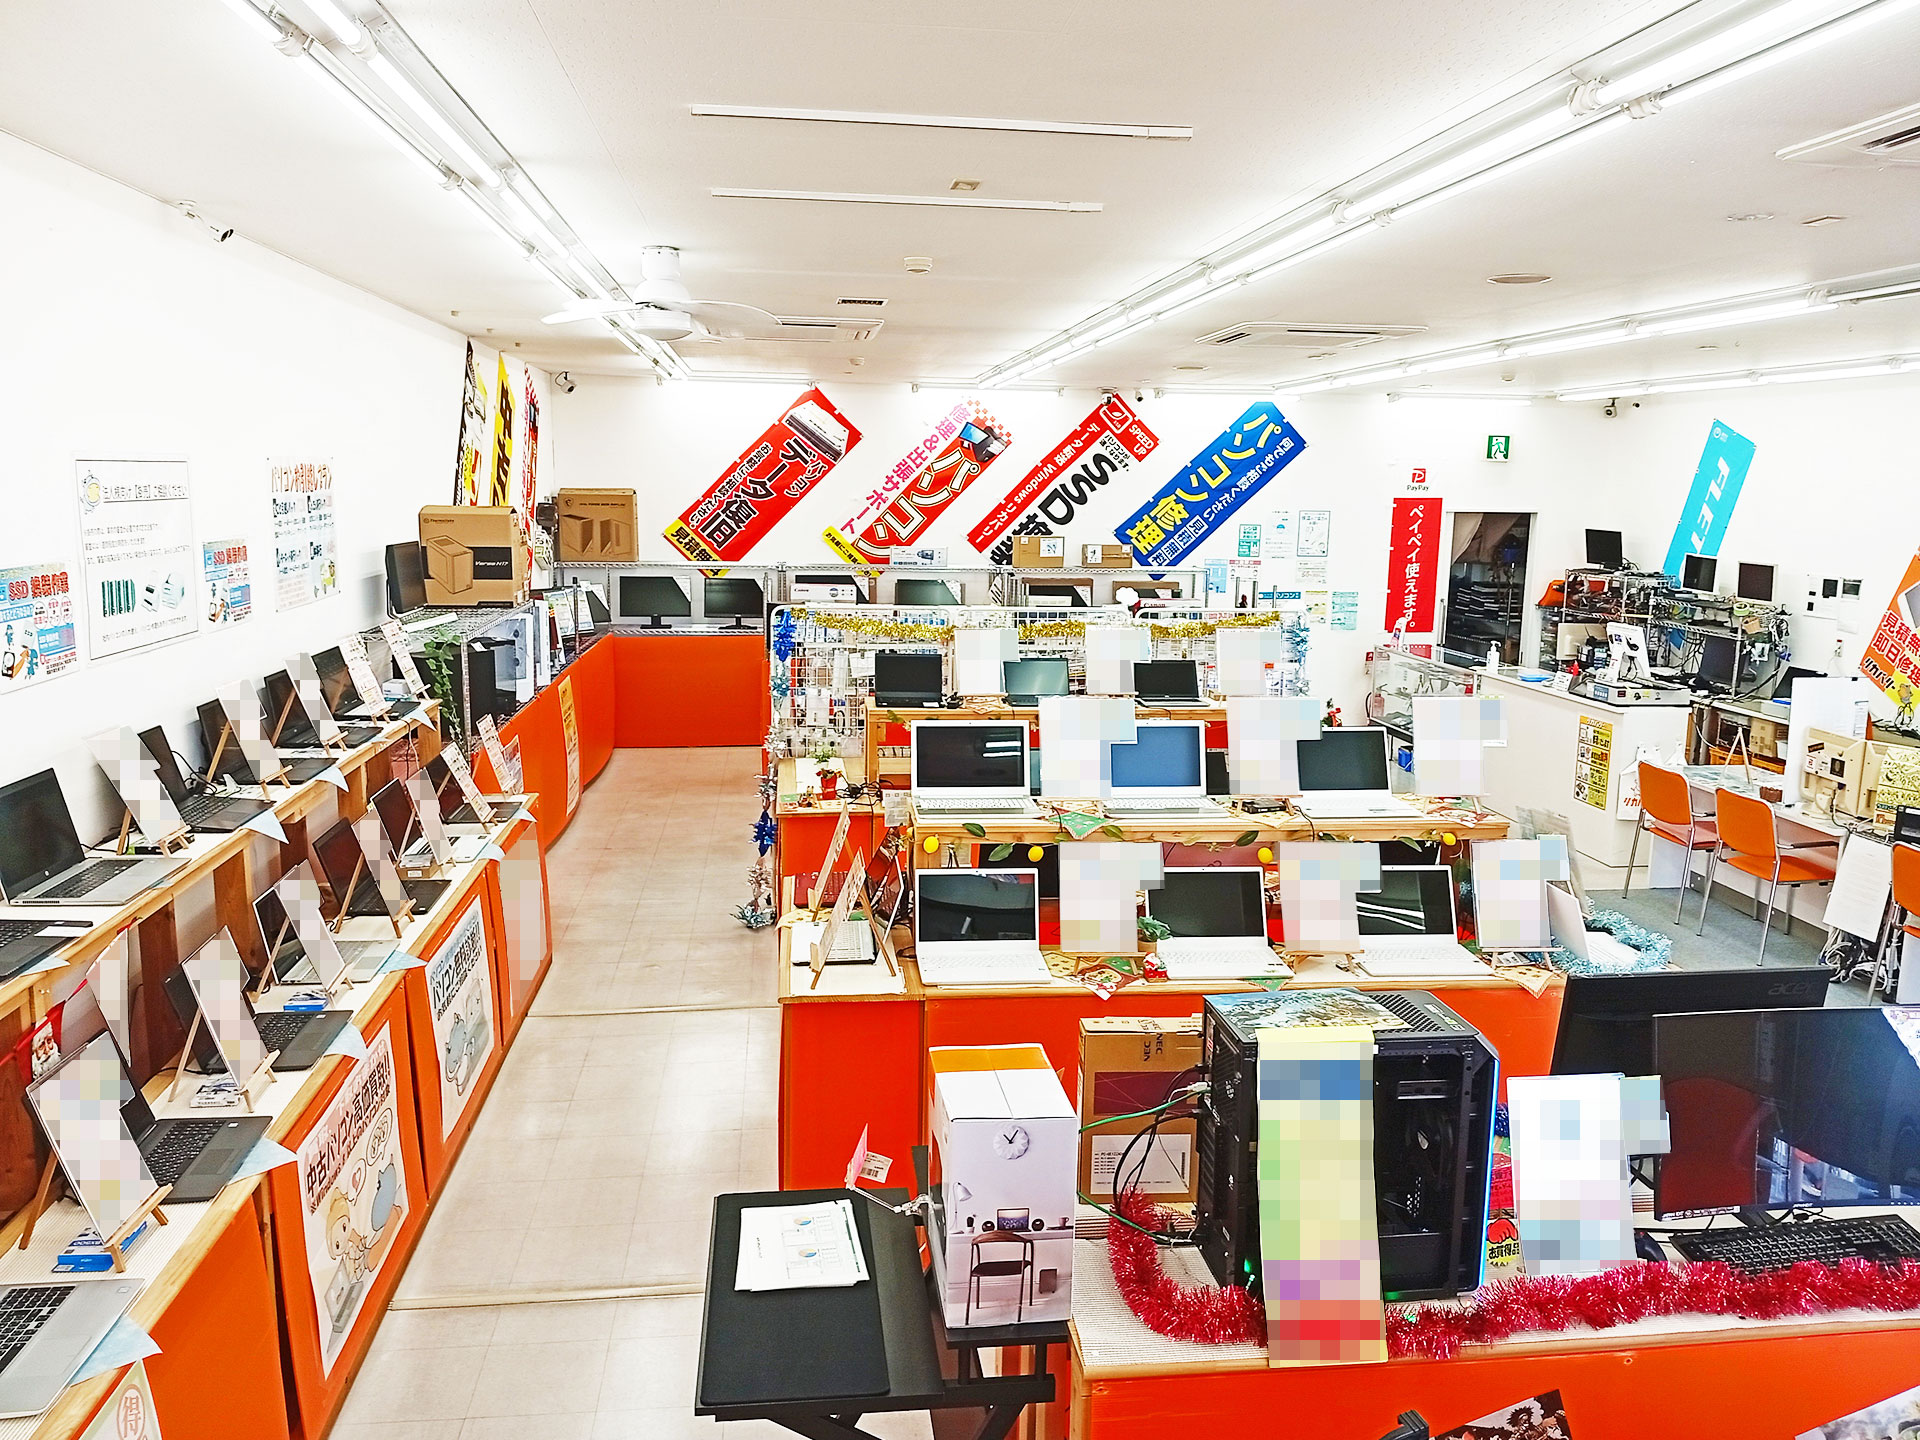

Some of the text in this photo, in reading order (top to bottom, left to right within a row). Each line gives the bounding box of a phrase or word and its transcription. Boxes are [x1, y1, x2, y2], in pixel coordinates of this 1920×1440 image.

[1129, 423, 1155, 449] SPEED
[1134, 443, 1147, 456] UP
[698, 436, 817, 551] データ復旧
[785, 459, 828, 498] パソコン
[1014, 463, 1056, 504] Windows
[1126, 413, 1282, 555] パソコン修理
[1203, 437, 1295, 522] 何でもご相談ください
[1407, 484, 1429, 492] PayPay
[856, 449, 980, 557] パソコン
[975, 503, 1017, 544] リカバリー
[1403, 504, 1424, 628] ペイペイ使えます。
[9, 580, 28, 601] SSD
[1864, 657, 1896, 690] リカバリー
[1768, 981, 1813, 997] acer
[1155, 1033, 1164, 1054] NEC
[307, 1051, 391, 1198] 中古パソコン高価買取!!
[121, 1395, 144, 1438] 得
